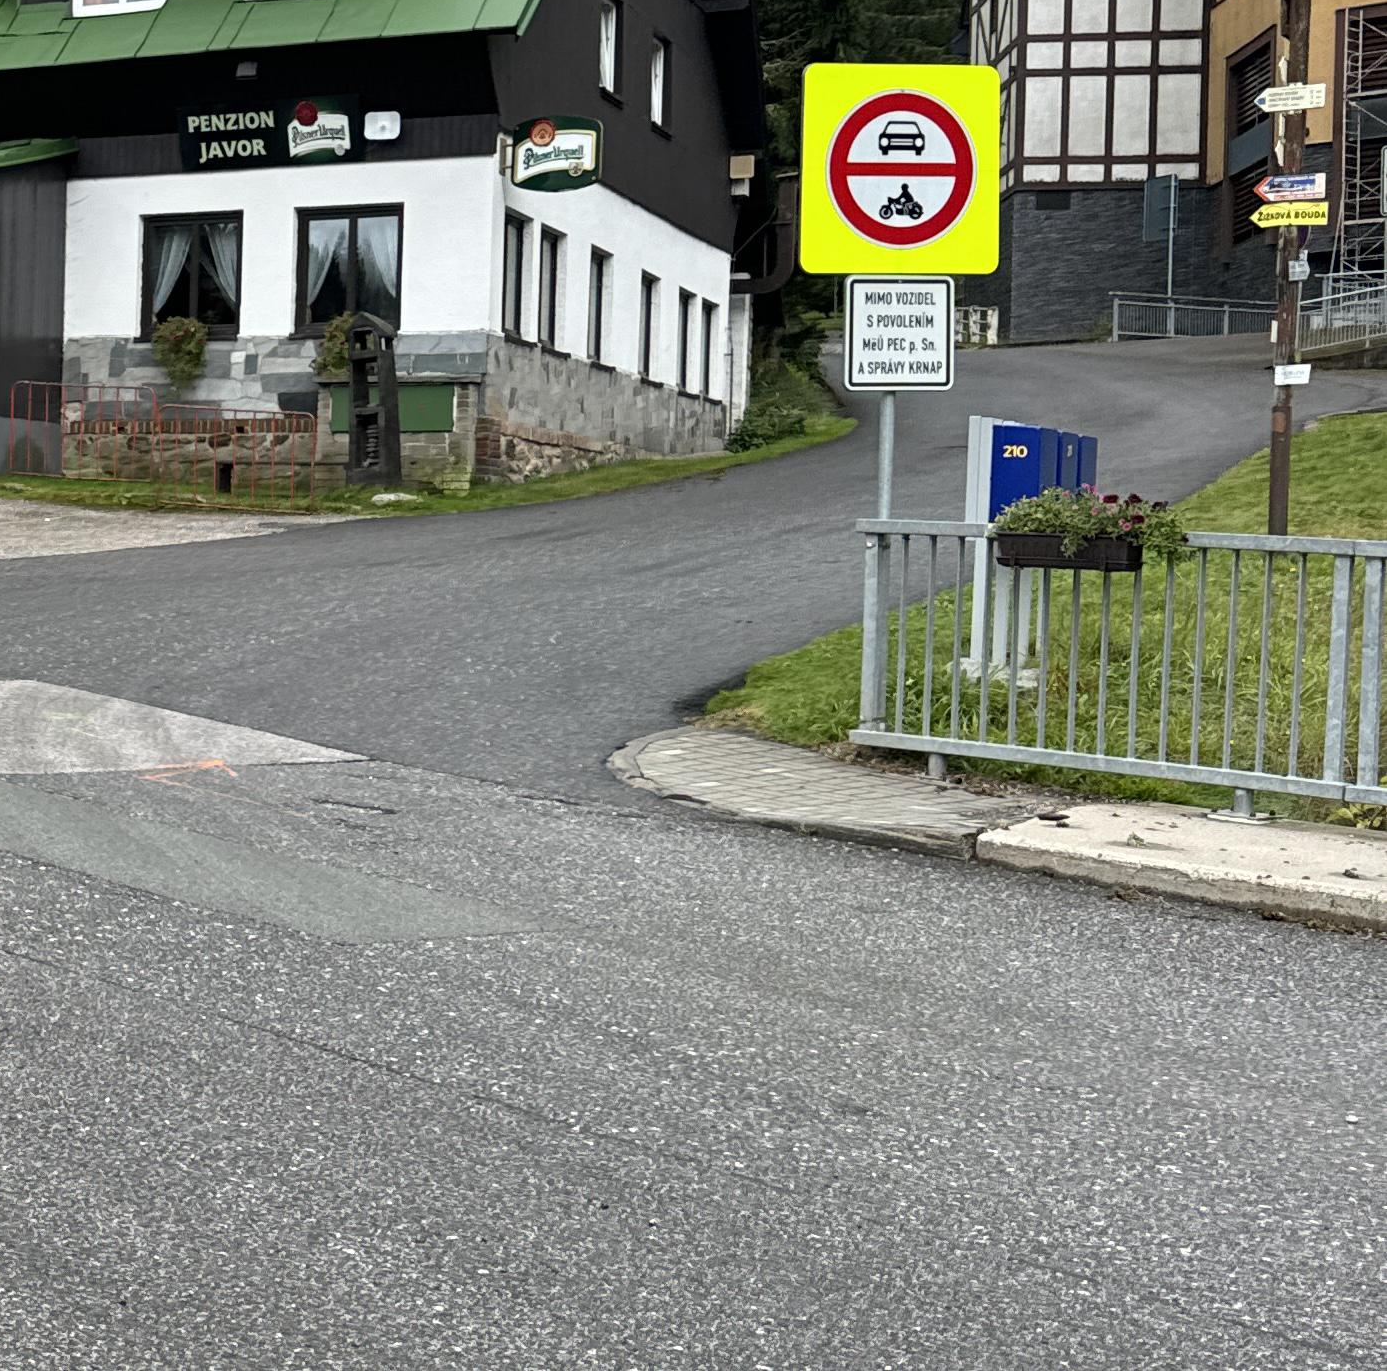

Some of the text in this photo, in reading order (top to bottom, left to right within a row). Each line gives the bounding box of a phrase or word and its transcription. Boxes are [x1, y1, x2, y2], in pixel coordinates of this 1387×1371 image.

[187, 110, 275, 133] PENZION
[199, 138, 267, 164] JAVOR
[552, 145, 584, 161] Urquell
[1294, 210, 1326, 219] BOUDA
[864, 292, 936, 305] MIMO VOZIDEL
[867, 312, 934, 328] S POVOLENÍM
[887, 338, 906, 351] PEC
[858, 359, 943, 374] A SPRÁVY KRNAP
[1002, 445, 1028, 458] 210
